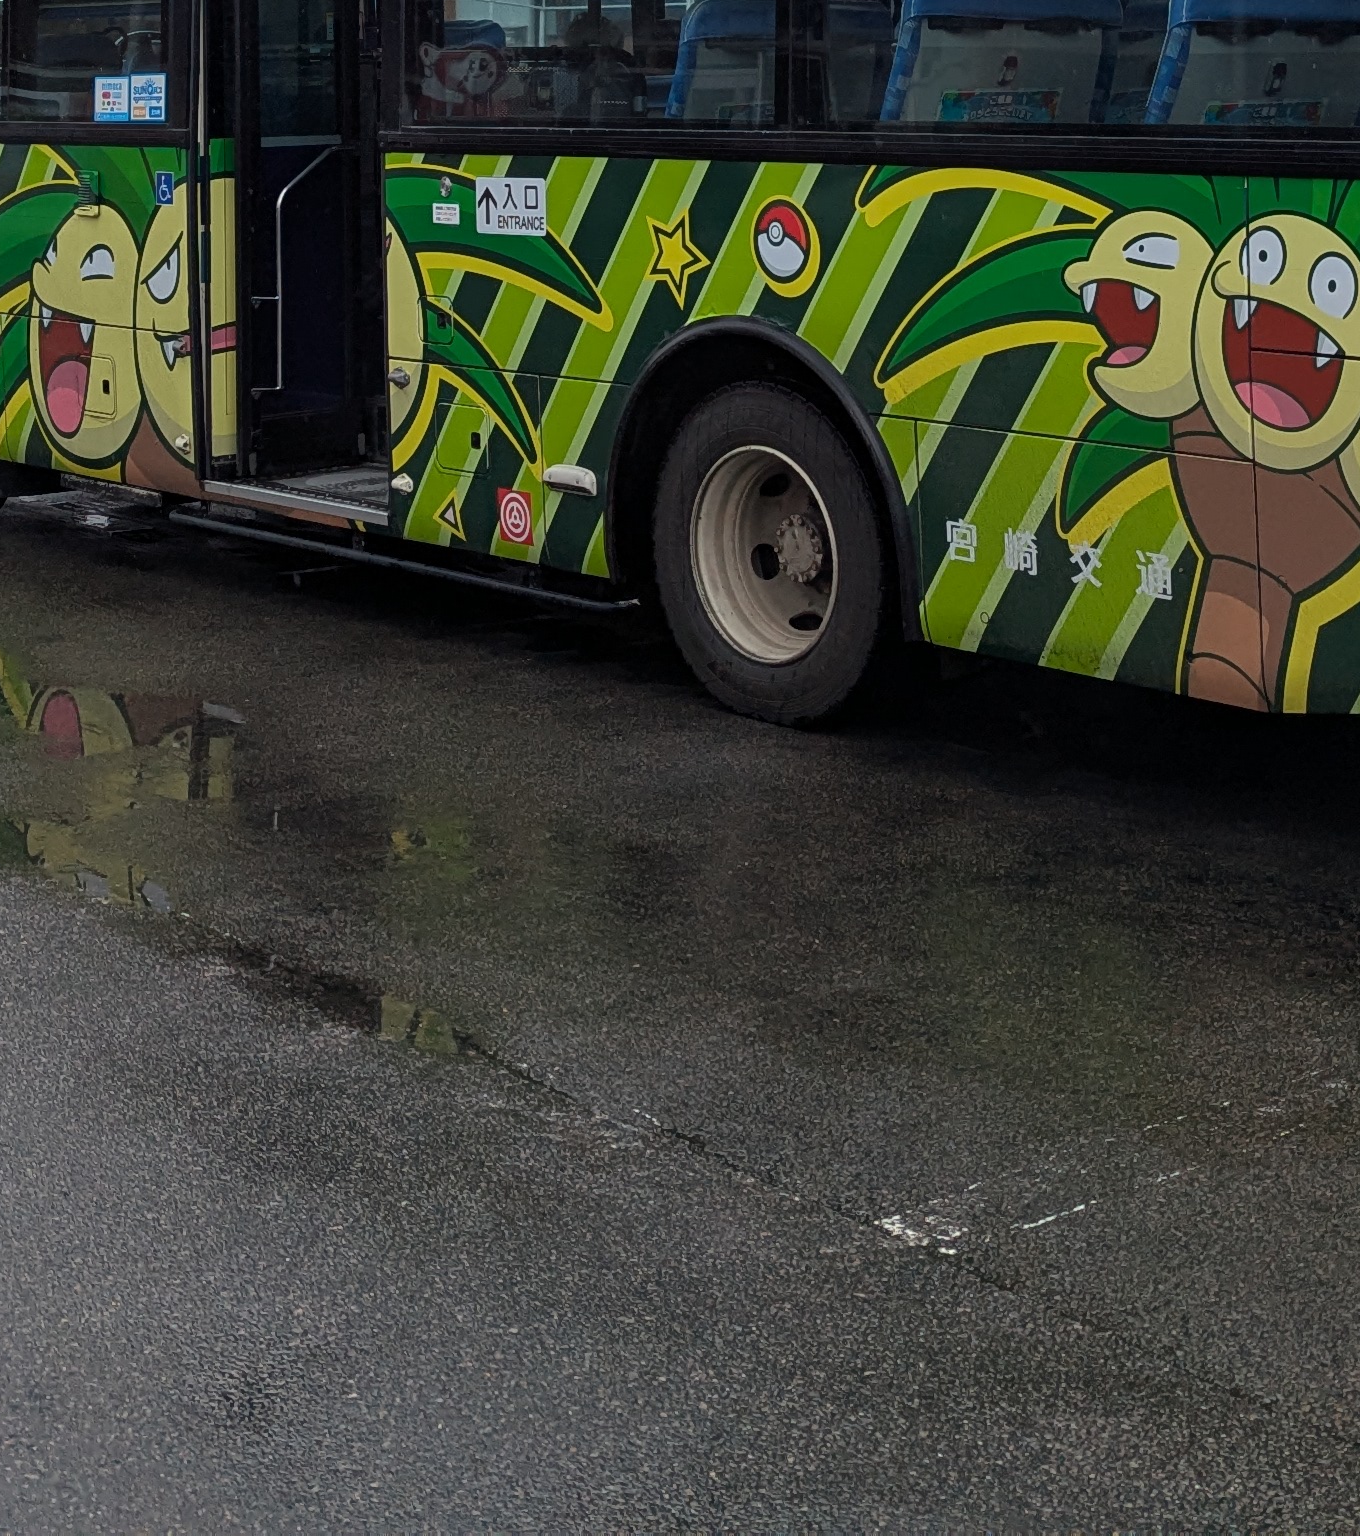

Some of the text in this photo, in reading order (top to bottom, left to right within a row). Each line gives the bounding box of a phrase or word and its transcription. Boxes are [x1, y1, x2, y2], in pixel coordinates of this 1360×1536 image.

[502, 183, 539, 210] 入口
[497, 214, 545, 231] ENTRANCE
[946, 518, 1173, 601] 宮崎交通
